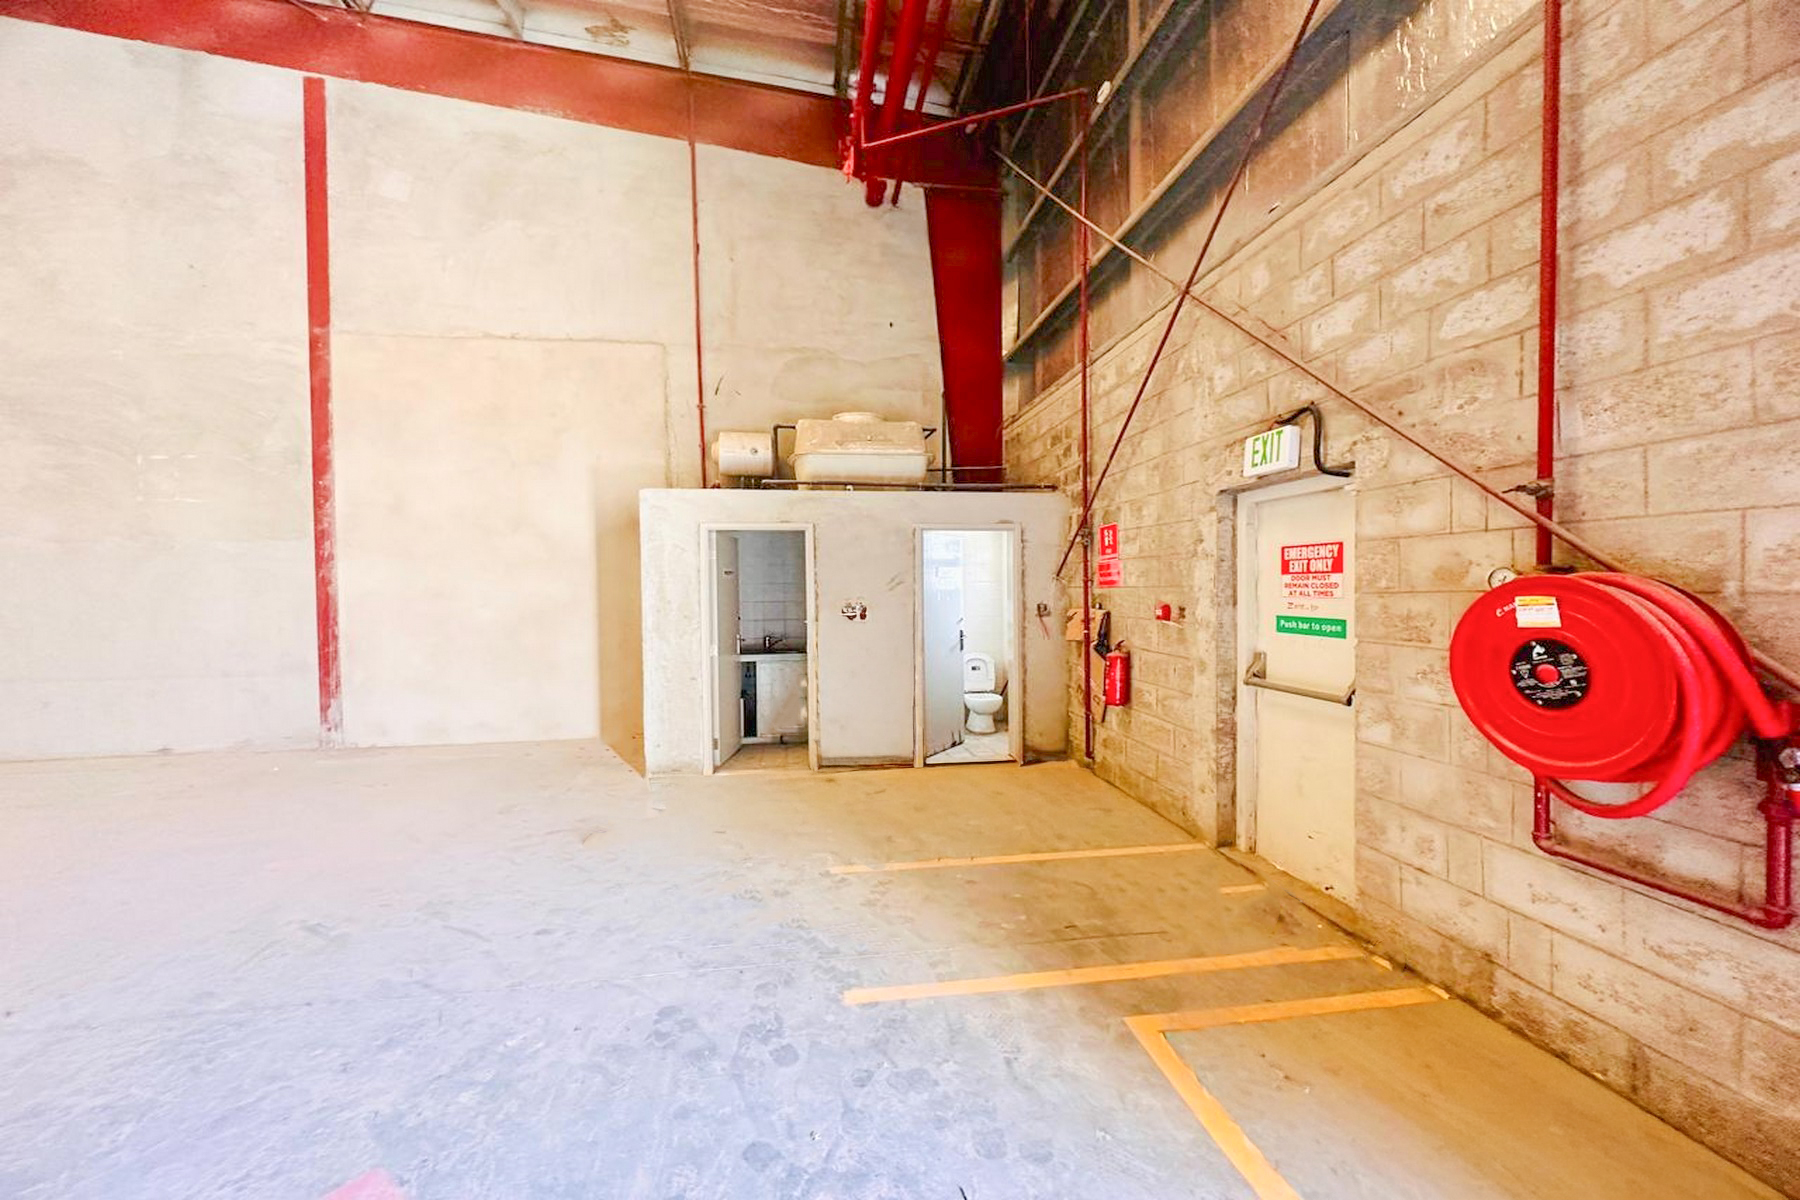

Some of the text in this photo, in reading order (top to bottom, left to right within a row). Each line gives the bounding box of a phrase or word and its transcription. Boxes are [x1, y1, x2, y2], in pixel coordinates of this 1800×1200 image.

[1251, 429, 1283, 469] EXIT
[1284, 544, 1339, 560] EMERGENCY
[1289, 559, 1333, 573] EXIT ONLY
[1280, 620, 1342, 632] Push bar to open
